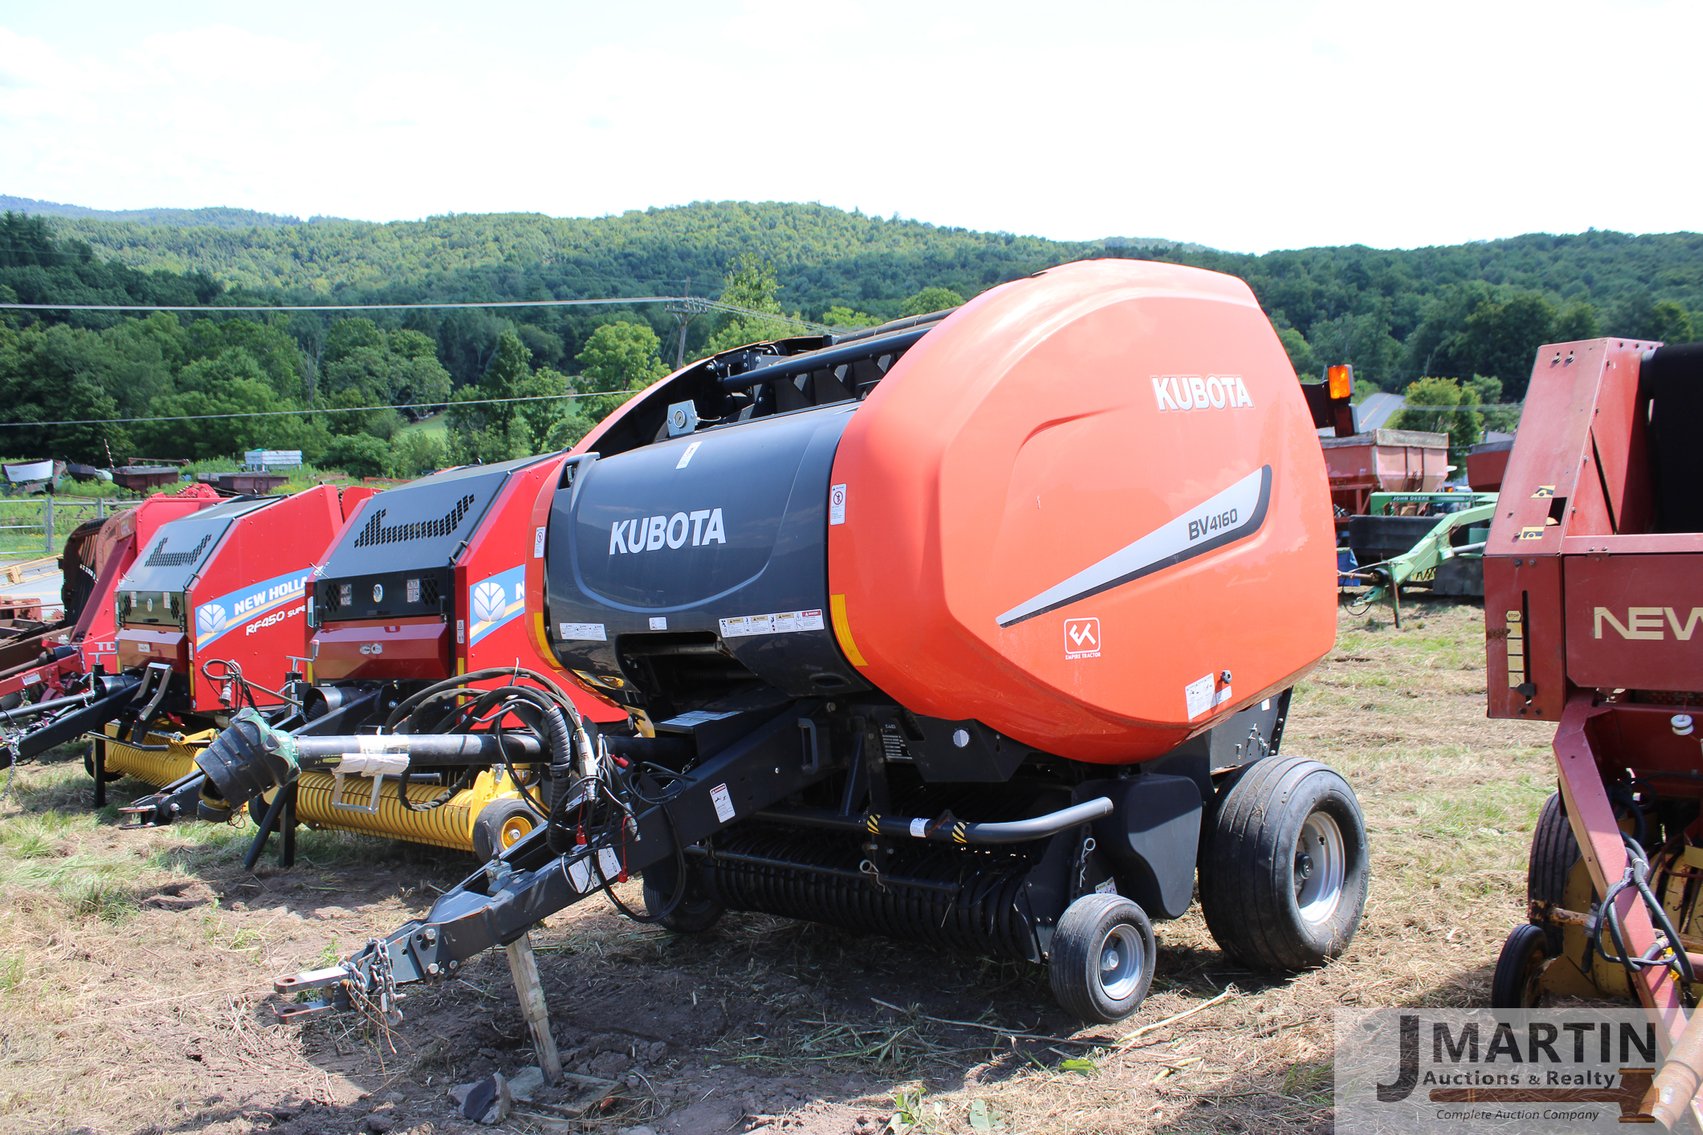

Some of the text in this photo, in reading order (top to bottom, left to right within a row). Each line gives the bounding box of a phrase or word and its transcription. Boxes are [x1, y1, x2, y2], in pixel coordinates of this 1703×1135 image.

[1152, 374, 1254, 412] KUBOTA
[609, 507, 726, 555] KUBOTA
[1188, 508, 1239, 541] BV4160
[234, 590, 267, 616] NEW
[246, 611, 286, 636] RF450
[1593, 606, 1703, 641] NEW
